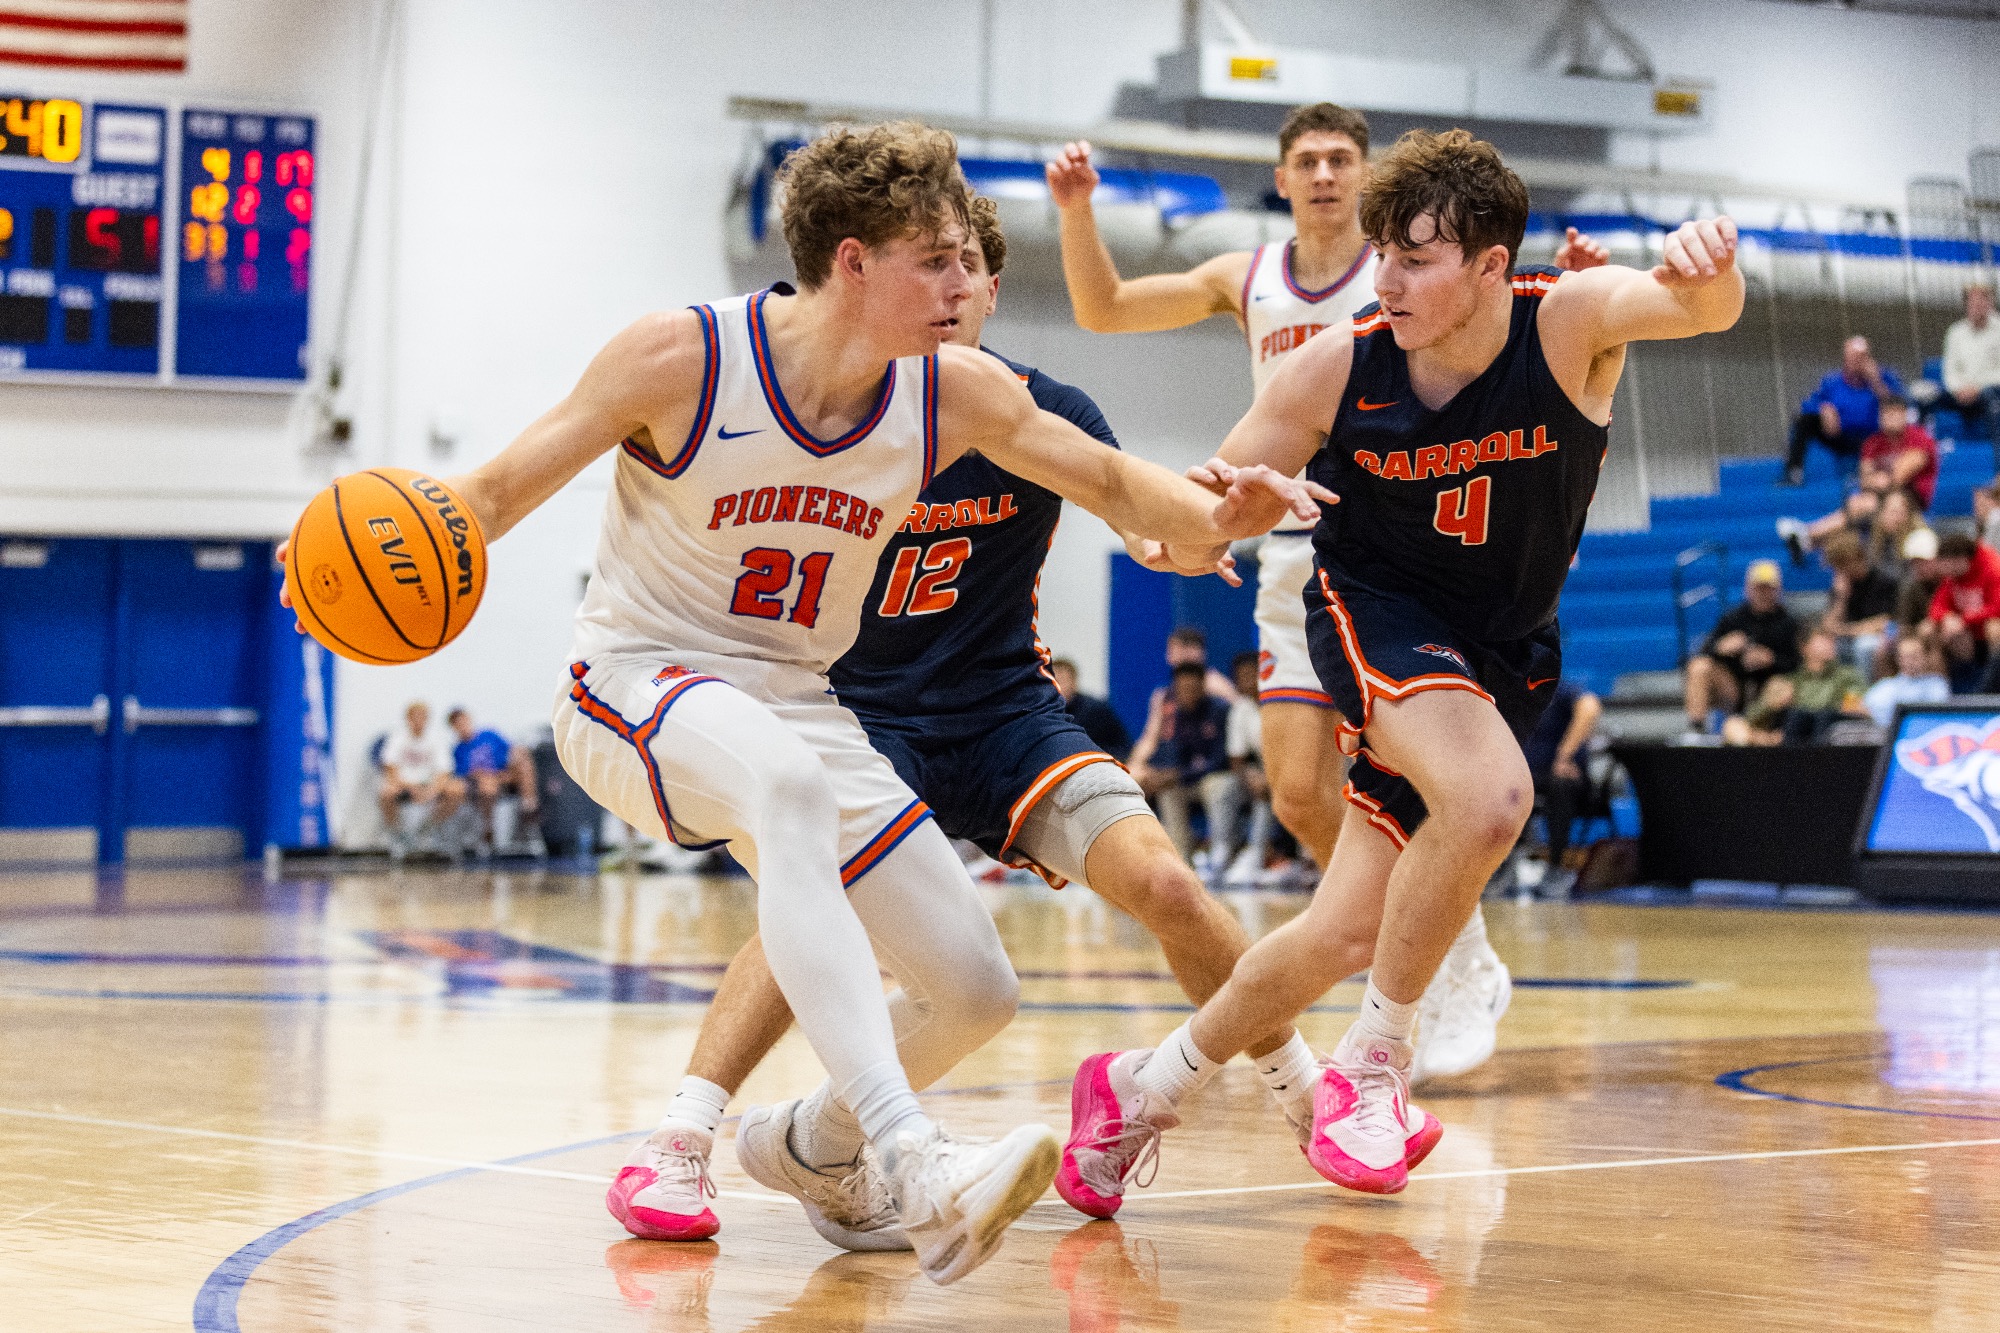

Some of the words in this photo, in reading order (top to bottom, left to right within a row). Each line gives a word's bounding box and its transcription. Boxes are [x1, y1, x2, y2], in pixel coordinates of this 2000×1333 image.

[72, 174, 158, 209] GUEST
[1354, 424, 1558, 481] CARROLL
[409, 477, 473, 598] Wilson
[708, 485, 884, 540] PIONEERS
[897, 494, 1018, 534] RROLL
[1434, 476, 1491, 545] 4
[367, 516, 421, 585] EVO
[878, 537, 972, 617] 12
[729, 547, 834, 628] 21
